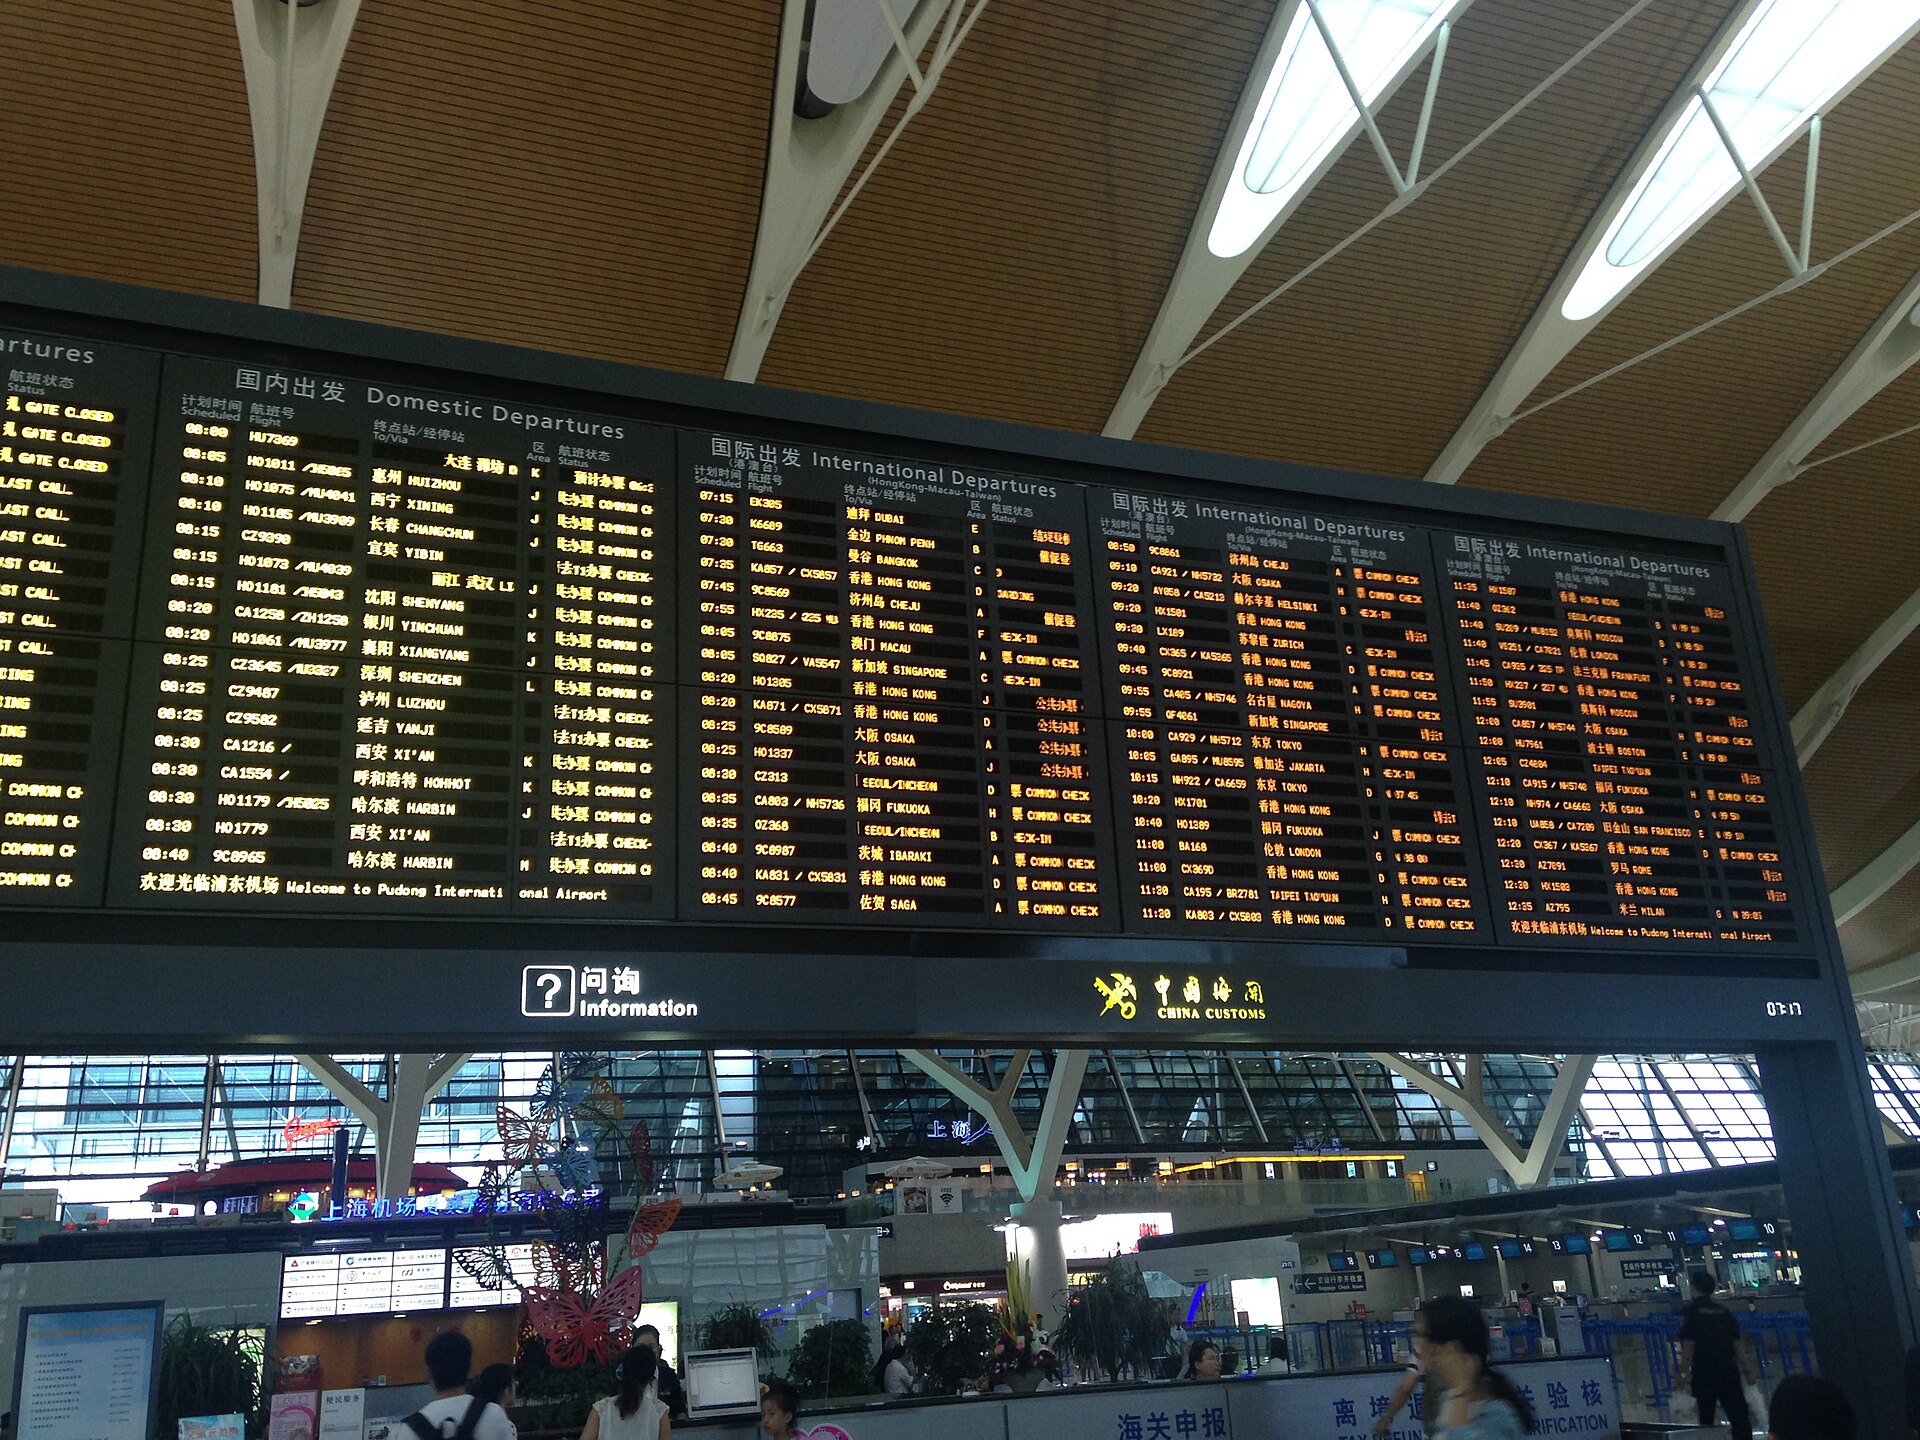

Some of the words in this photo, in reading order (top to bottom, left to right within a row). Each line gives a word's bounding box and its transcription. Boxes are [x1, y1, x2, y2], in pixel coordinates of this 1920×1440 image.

[9, 369, 75, 389] 航班状态
[7, 382, 46, 395] Status
[235, 368, 346, 403] 国内出发
[366, 386, 483, 420] Domestic
[492, 405, 625, 441] Departures
[181, 393, 243, 413] 计划时间
[249, 402, 296, 420] 航班号
[373, 419, 465, 443] 终点站/经停站
[532, 441, 545, 454] 区
[558, 444, 611, 463] 航班状态
[181, 405, 241, 422] Scheduled
[249, 414, 283, 428] Flight
[373, 430, 408, 445] To/Via
[526, 452, 551, 464] Area
[558, 457, 589, 469] Status
[711, 437, 801, 467] 国际出发
[813, 452, 944, 483] International
[952, 470, 1057, 498] Departures
[372, 468, 402, 485] 惠州
[408, 476, 462, 491] HUIZHOU
[694, 465, 742, 481] 计划时间
[748, 472, 783, 486] 航班号
[991, 502, 1034, 518] 航班状态
[695, 475, 742, 489] Scheduled
[748, 482, 773, 493] Flight
[844, 494, 873, 506] To/Via
[967, 510, 987, 520] Area
[991, 513, 1017, 524] Status
[371, 492, 402, 508] 西宁
[407, 499, 454, 514] XINING
[699, 491, 733, 503] 07:15
[749, 497, 782, 509] EK305
[846, 507, 870, 521] 迪拜
[874, 513, 904, 524] DUBAI
[1113, 491, 1188, 519] 国际出发
[1195, 503, 1308, 530] International
[1314, 518, 1405, 542] Departures
[369, 515, 401, 533] 长春
[406, 523, 475, 540] CHANGCHUN
[699, 513, 733, 525] 07:30
[846, 528, 871, 542] 金边
[405, 547, 444, 561] YIBIN
[750, 541, 783, 553] TG663
[876, 555, 918, 568] BANGKOK
[1454, 535, 1521, 559] 国际出发
[1527, 544, 1625, 569] International
[1630, 556, 1711, 579] Departures
[750, 563, 783, 574] KA857
[848, 571, 872, 585] 香港
[877, 577, 902, 587] HONG
[906, 580, 931, 590] KONG
[1109, 561, 1137, 572] 09:10
[1255, 578, 1281, 588] OSAKA
[365, 589, 397, 606] 沈阳
[402, 596, 465, 612] SHENYANG
[700, 580, 734, 592] 07:45
[889, 600, 920, 611] CHEJU
[1277, 600, 1317, 611] HELSINKI
[168, 600, 213, 614] 08:20
[363, 614, 395, 631] 银川
[401, 621, 464, 636] YINCHUAN
[1272, 639, 1304, 649] ZURICH
[400, 646, 470, 661] XIANGYANG
[163, 653, 209, 667] 08:25
[399, 671, 462, 686] SHENZHEN
[892, 665, 947, 678] SINGAPORE
[1118, 664, 1147, 674] 09:45
[1612, 672, 1650, 681] FRANKFURT
[397, 697, 446, 710] LUZHOU
[1280, 699, 1312, 709] NAGOYA
[1282, 720, 1329, 731] SINGAPORE
[854, 727, 879, 742] 大阪
[883, 733, 915, 743] OSAKA
[1250, 735, 1271, 749] 东京
[1276, 740, 1302, 750] TOKYO
[223, 739, 276, 753] CA1216
[356, 743, 388, 761] 西安
[394, 749, 435, 761] XI'AN
[1618, 747, 1646, 756] BOSTON
[1288, 763, 1325, 772] JAKARTA
[221, 766, 273, 780] CA1554
[424, 777, 472, 789] HOHHOT
[352, 796, 401, 814] 哈尔滨
[407, 802, 456, 815] HARBIN
[886, 803, 930, 814] FUKUOKA
[1286, 826, 1323, 836] FUKUOKA
[1634, 826, 1649, 834] SAN
[1651, 827, 1692, 837] FRANCISCO
[889, 850, 931, 862] IBARAKI
[1178, 841, 1207, 852] BA168
[1288, 848, 1321, 857] LONDON
[403, 857, 453, 869] HARBIN
[140, 872, 280, 894] 欢迎光临浦东机场
[286, 881, 347, 894] Welcome
[353, 884, 372, 895] to
[378, 883, 427, 897] Pudong
[556, 888, 608, 900] Airport
[701, 892, 737, 904] 08:45
[755, 895, 796, 906] 9C8577
[890, 899, 917, 910] SAGA
[1641, 907, 1665, 916] MILAN
[1511, 920, 1588, 935] 欢迎光临浦东机场
[1591, 927, 1624, 935] Welcome
[1641, 928, 1669, 938] Pudong
[1742, 932, 1772, 940] Airport
[580, 966, 640, 995] 问询
[580, 999, 698, 1017] Information
[1157, 1007, 1200, 1019] CHINA
[1205, 1008, 1266, 1020] CUSTOMS
[1667, 1231, 1676, 1242] 11
[1763, 1223, 1775, 1236] 10
[1552, 1240, 1561, 1251] 13
[1633, 1234, 1643, 1245] 12
[1428, 1250, 1437, 1260] 16
[1453, 1248, 1462, 1259] 15
[1522, 1243, 1533, 1254] 14
[1346, 1256, 1354, 1266] 18
[1368, 1254, 1375, 1264] 17
